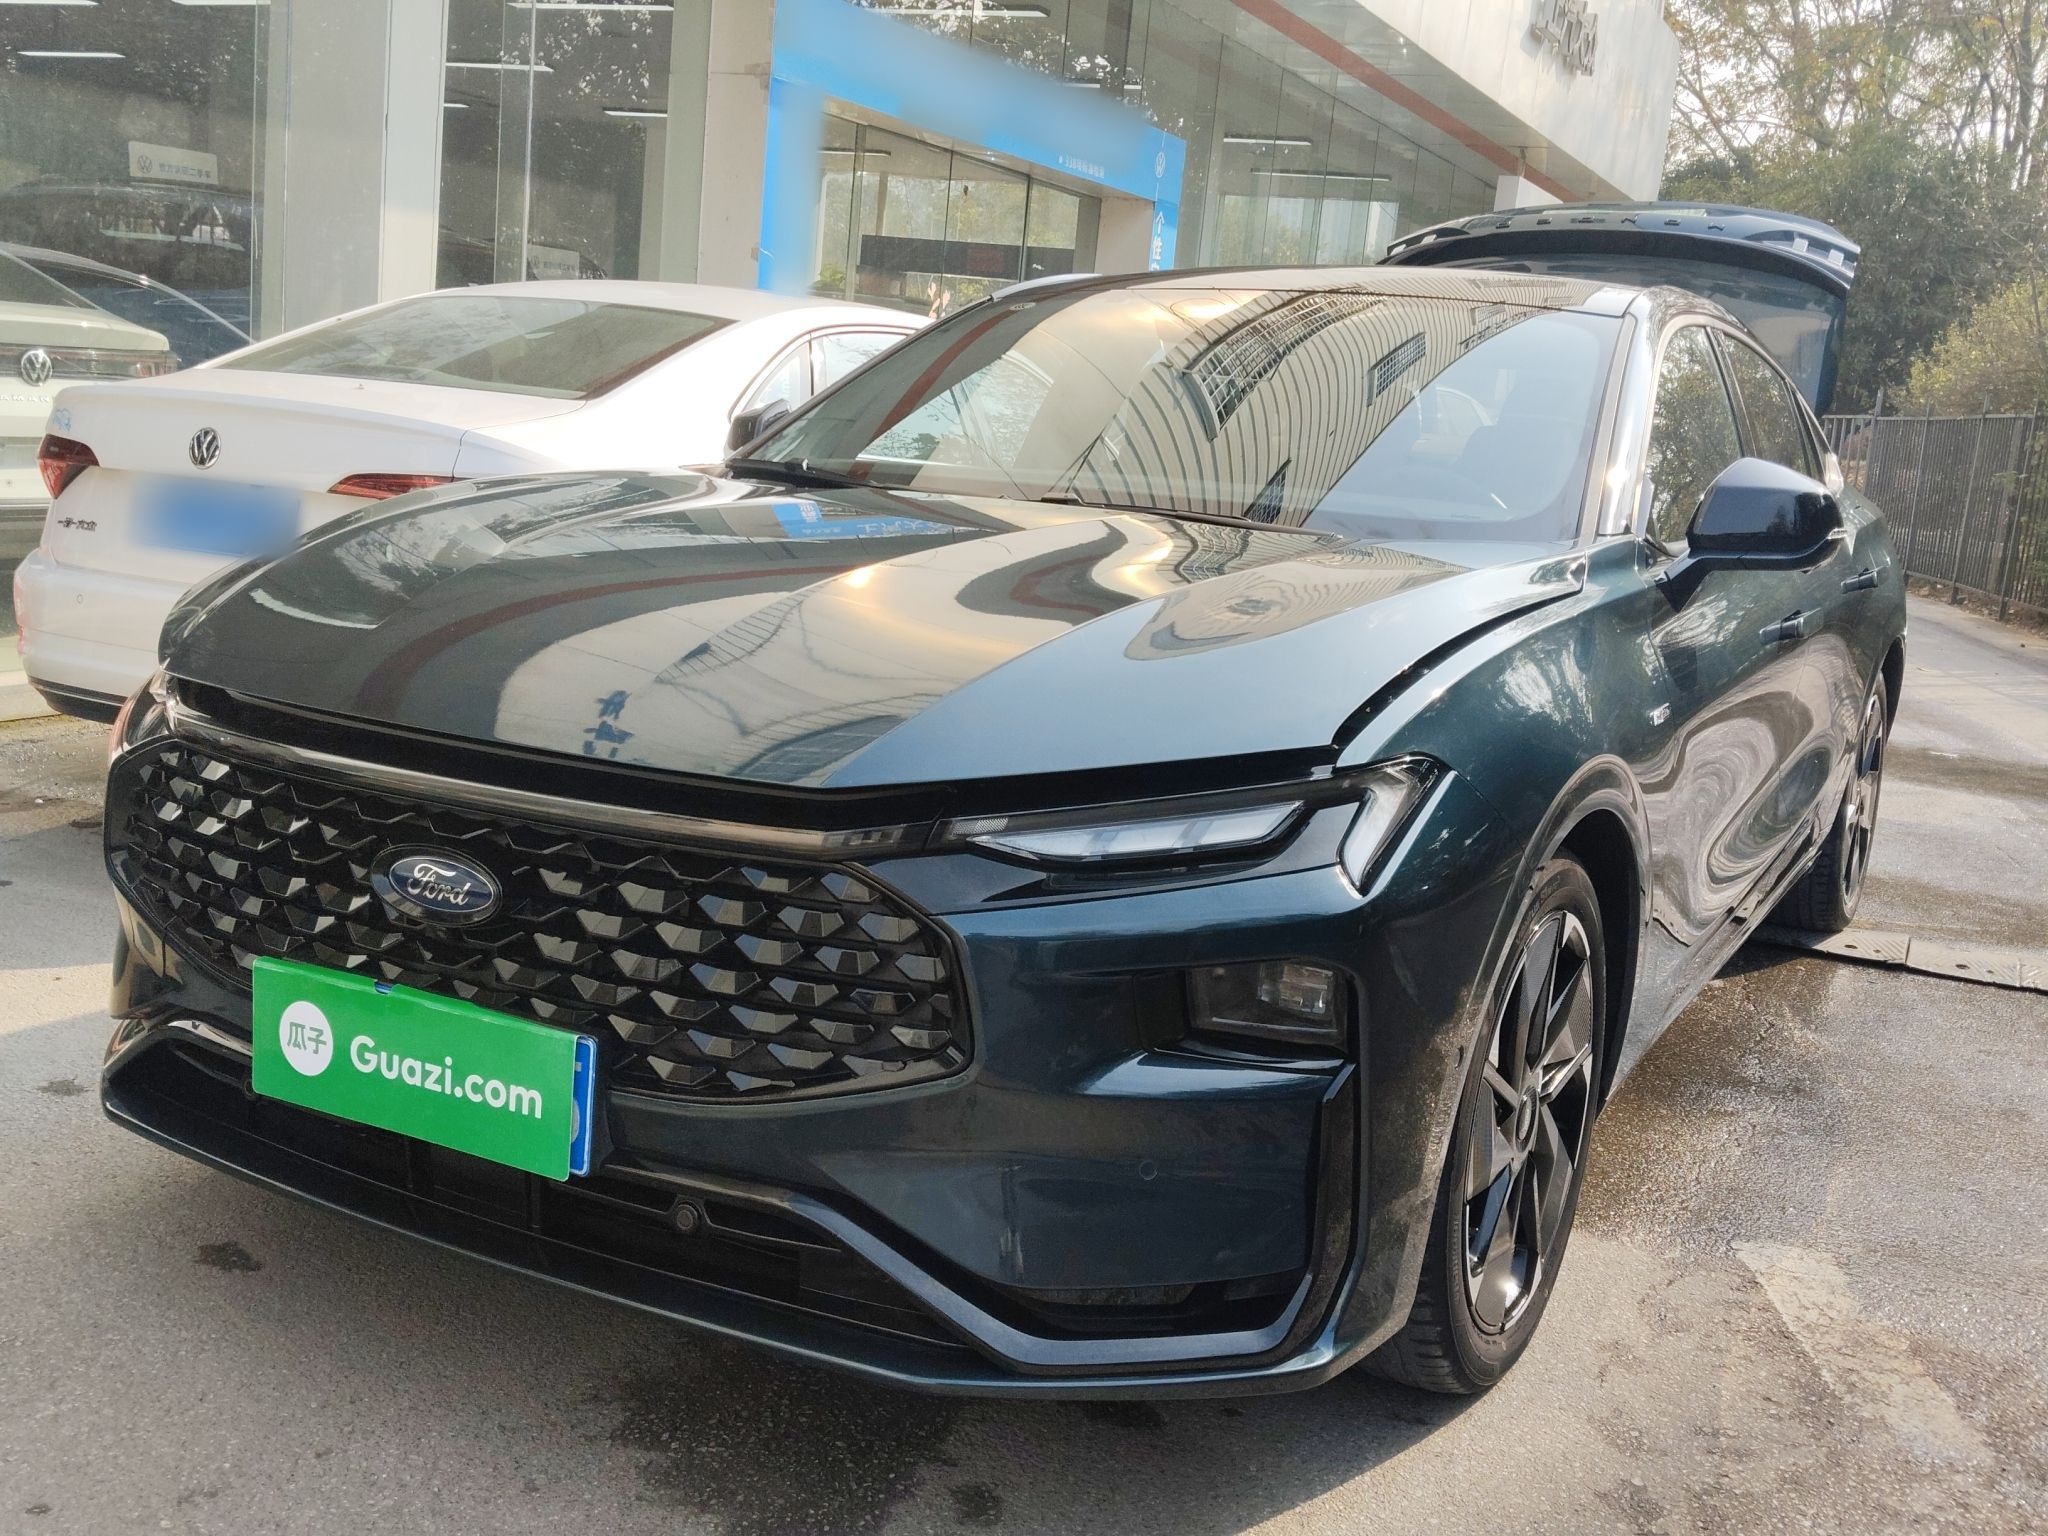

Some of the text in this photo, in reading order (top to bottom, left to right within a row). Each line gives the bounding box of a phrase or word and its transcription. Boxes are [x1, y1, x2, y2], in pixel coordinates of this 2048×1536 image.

[406, 863, 471, 906] Ford
[287, 1021, 328, 1055] 瓜子
[350, 1035, 543, 1120] Guazi.com
